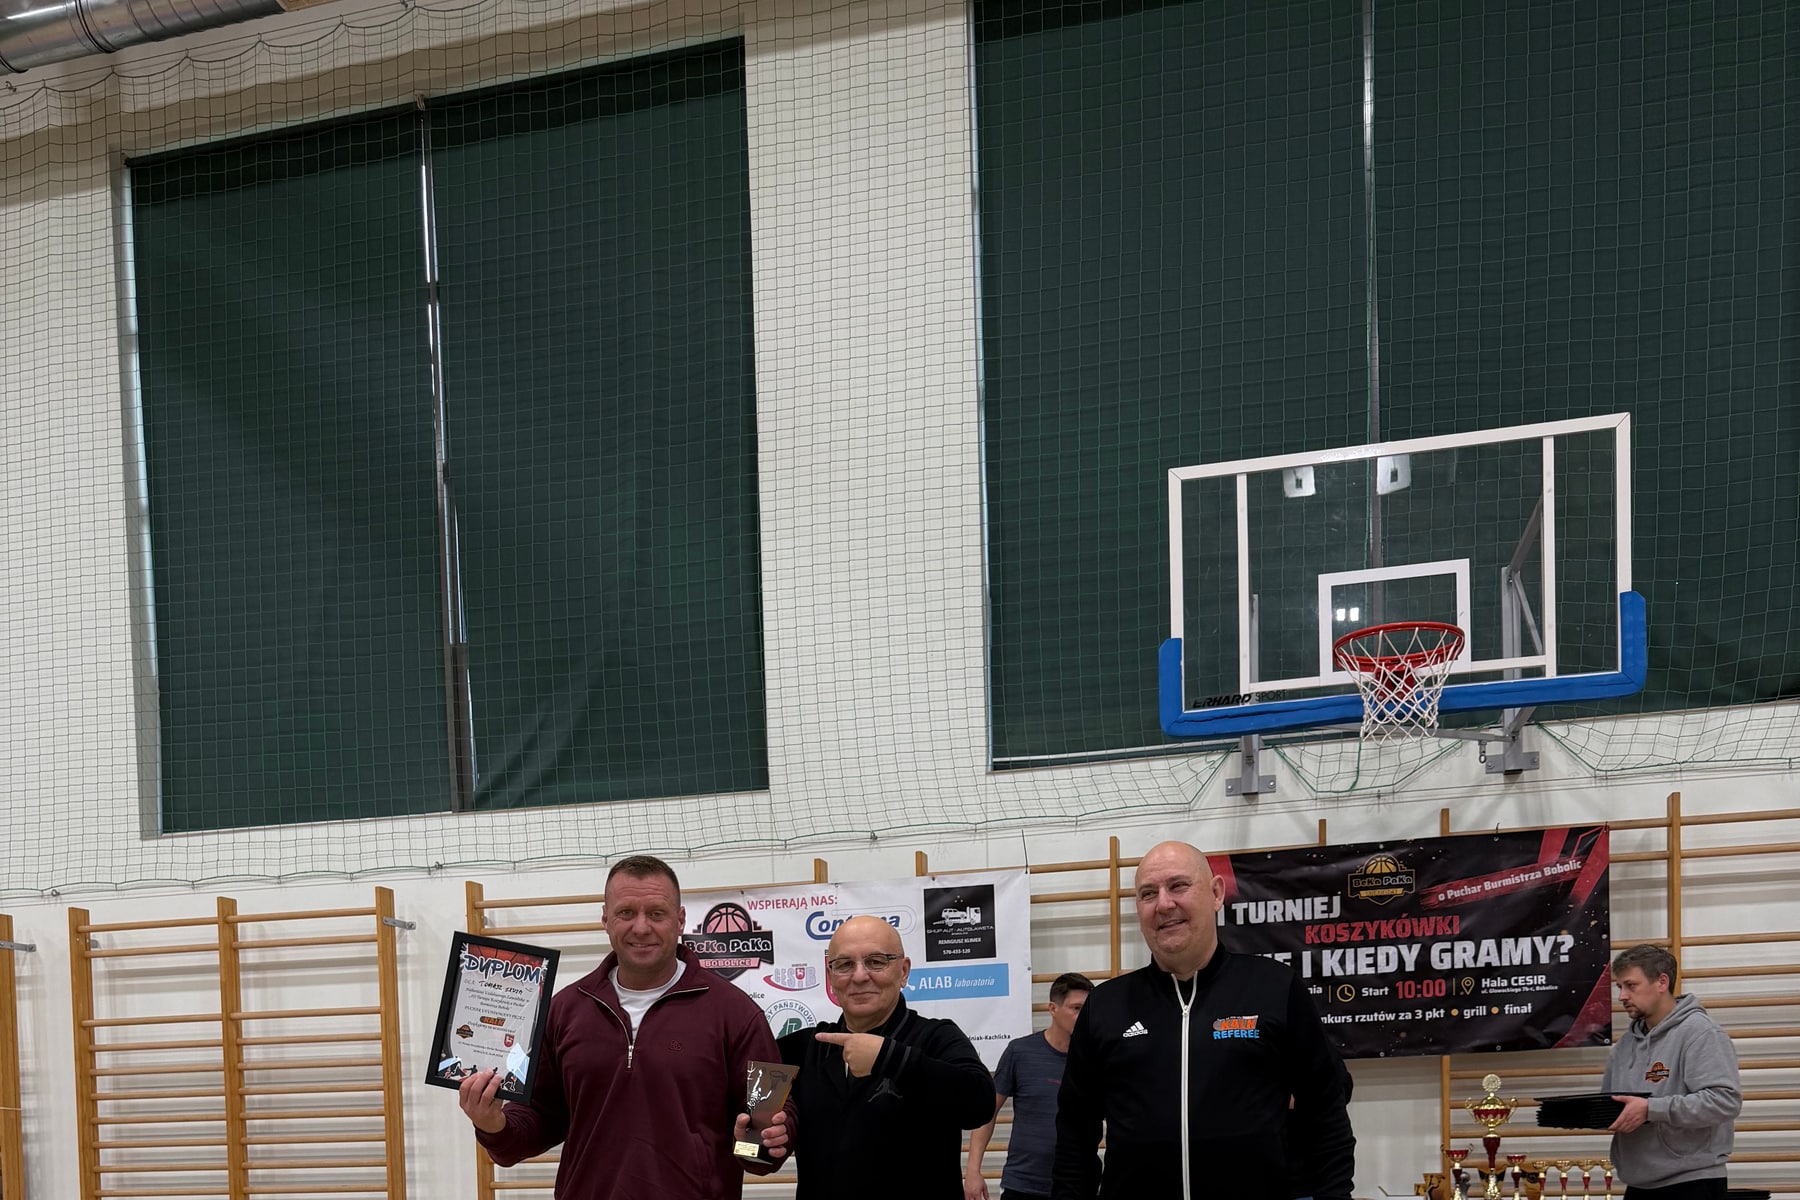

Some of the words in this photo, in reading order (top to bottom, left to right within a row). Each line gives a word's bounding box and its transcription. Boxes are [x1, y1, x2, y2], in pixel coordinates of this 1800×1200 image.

[1254, 689, 1288, 702] SPORT
[1438, 893, 1446, 901] o
[1447, 883, 1482, 899] Puchar
[1484, 870, 1542, 891] Burmistrza
[1543, 859, 1583, 877] Bobolic
[747, 896, 808, 911] WSPIERAJĄ
[810, 895, 838, 907] NAS:
[1231, 895, 1341, 926] TURNIEJ
[1305, 913, 1461, 945] KOSZYKÓWKI
[684, 940, 727, 954] BeKa
[729, 937, 772, 952] PaKa
[704, 959, 752, 967] BOBOLICE
[1301, 950, 1312, 978] I
[1322, 943, 1421, 977] KIEDY
[1430, 934, 1575, 970] GRAMY?
[464, 954, 541, 984] DYPLOM
[918, 975, 953, 990] ALAB
[954, 976, 996, 988] laboratoria
[1361, 986, 1390, 997] Start
[1396, 978, 1447, 999] 10:00
[1481, 977, 1508, 988] Hala
[1510, 974, 1547, 986] CESIR
[749, 991, 765, 999] olice
[1320, 1013, 1353, 1024] nkurs
[1355, 1010, 1396, 1022] rzutów
[1398, 1011, 1412, 1020] za
[1414, 1010, 1423, 1019] 3
[1425, 1008, 1445, 1021] pkt
[1463, 1005, 1487, 1019] grill
[1503, 1003, 1532, 1015] finał
[1212, 1029, 1260, 1040] REFEREE
